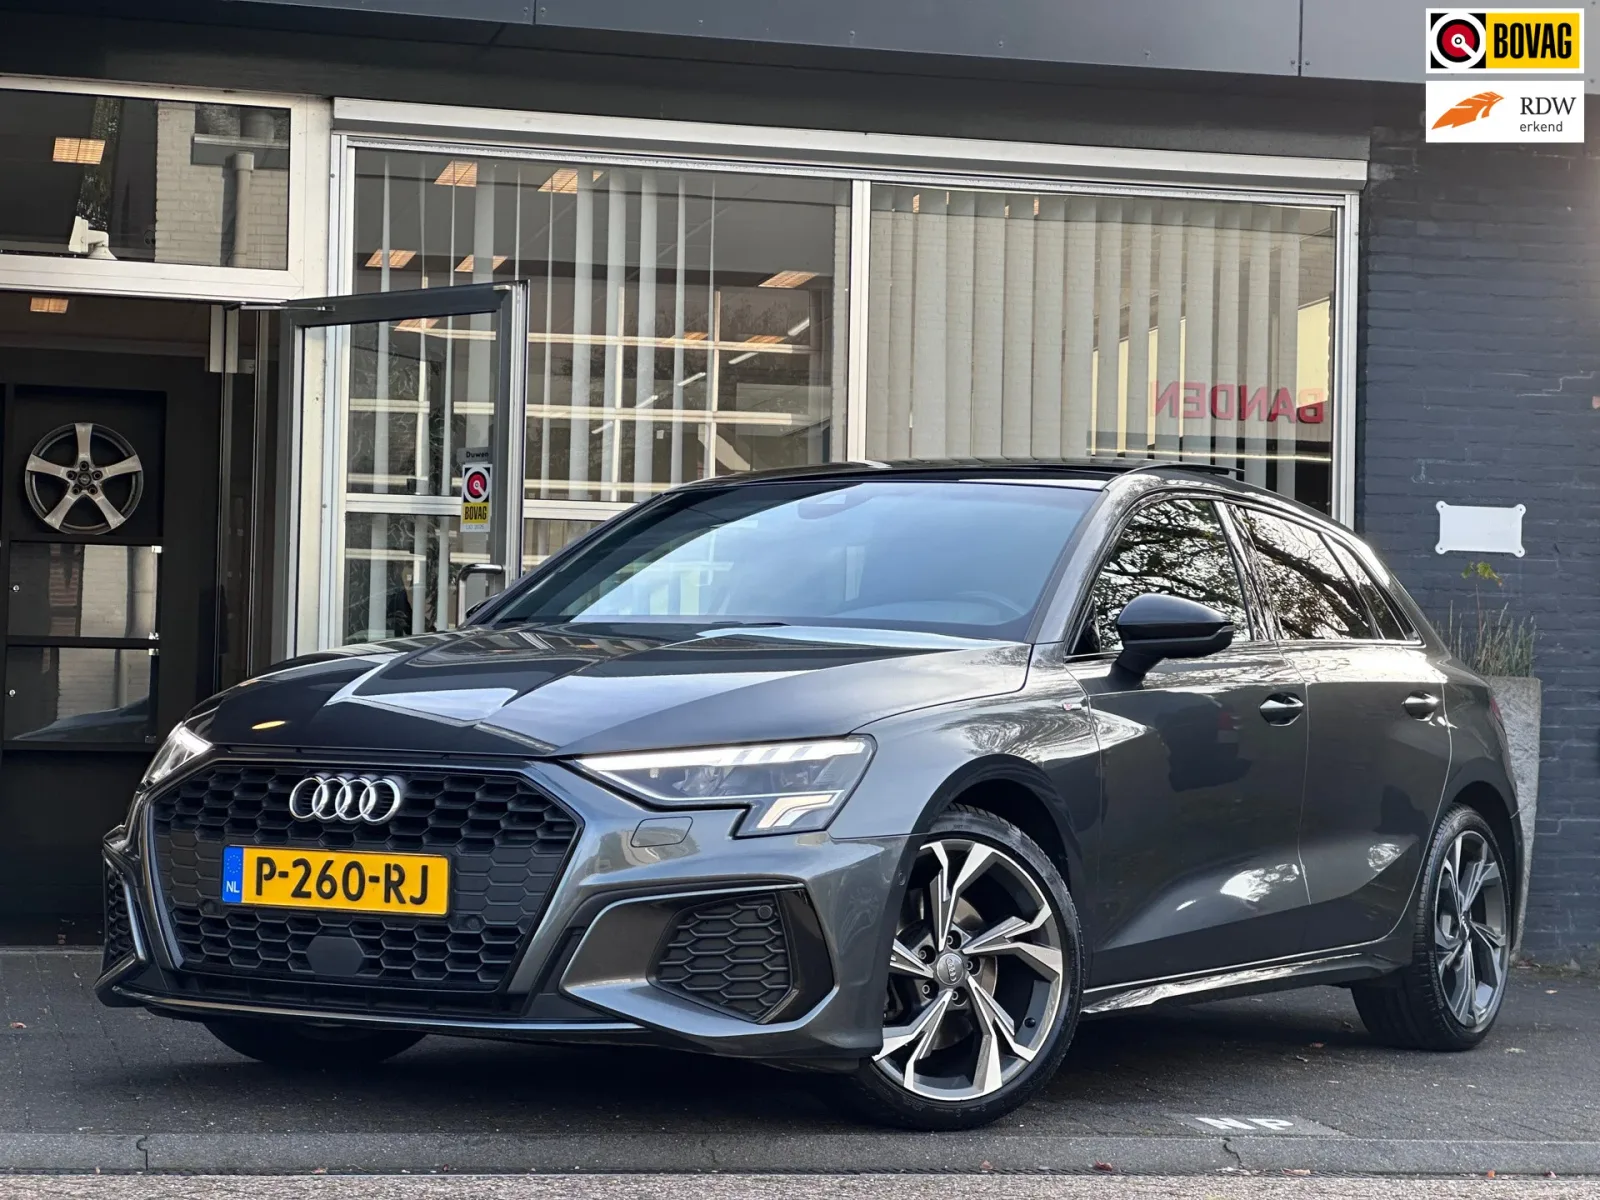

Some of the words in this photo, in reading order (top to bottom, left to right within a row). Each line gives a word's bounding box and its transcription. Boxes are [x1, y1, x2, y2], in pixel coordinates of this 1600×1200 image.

[464, 505, 487, 520] BOVAG
[226, 880, 240, 893] NL
[255, 856, 429, 905] P-260-RJ
